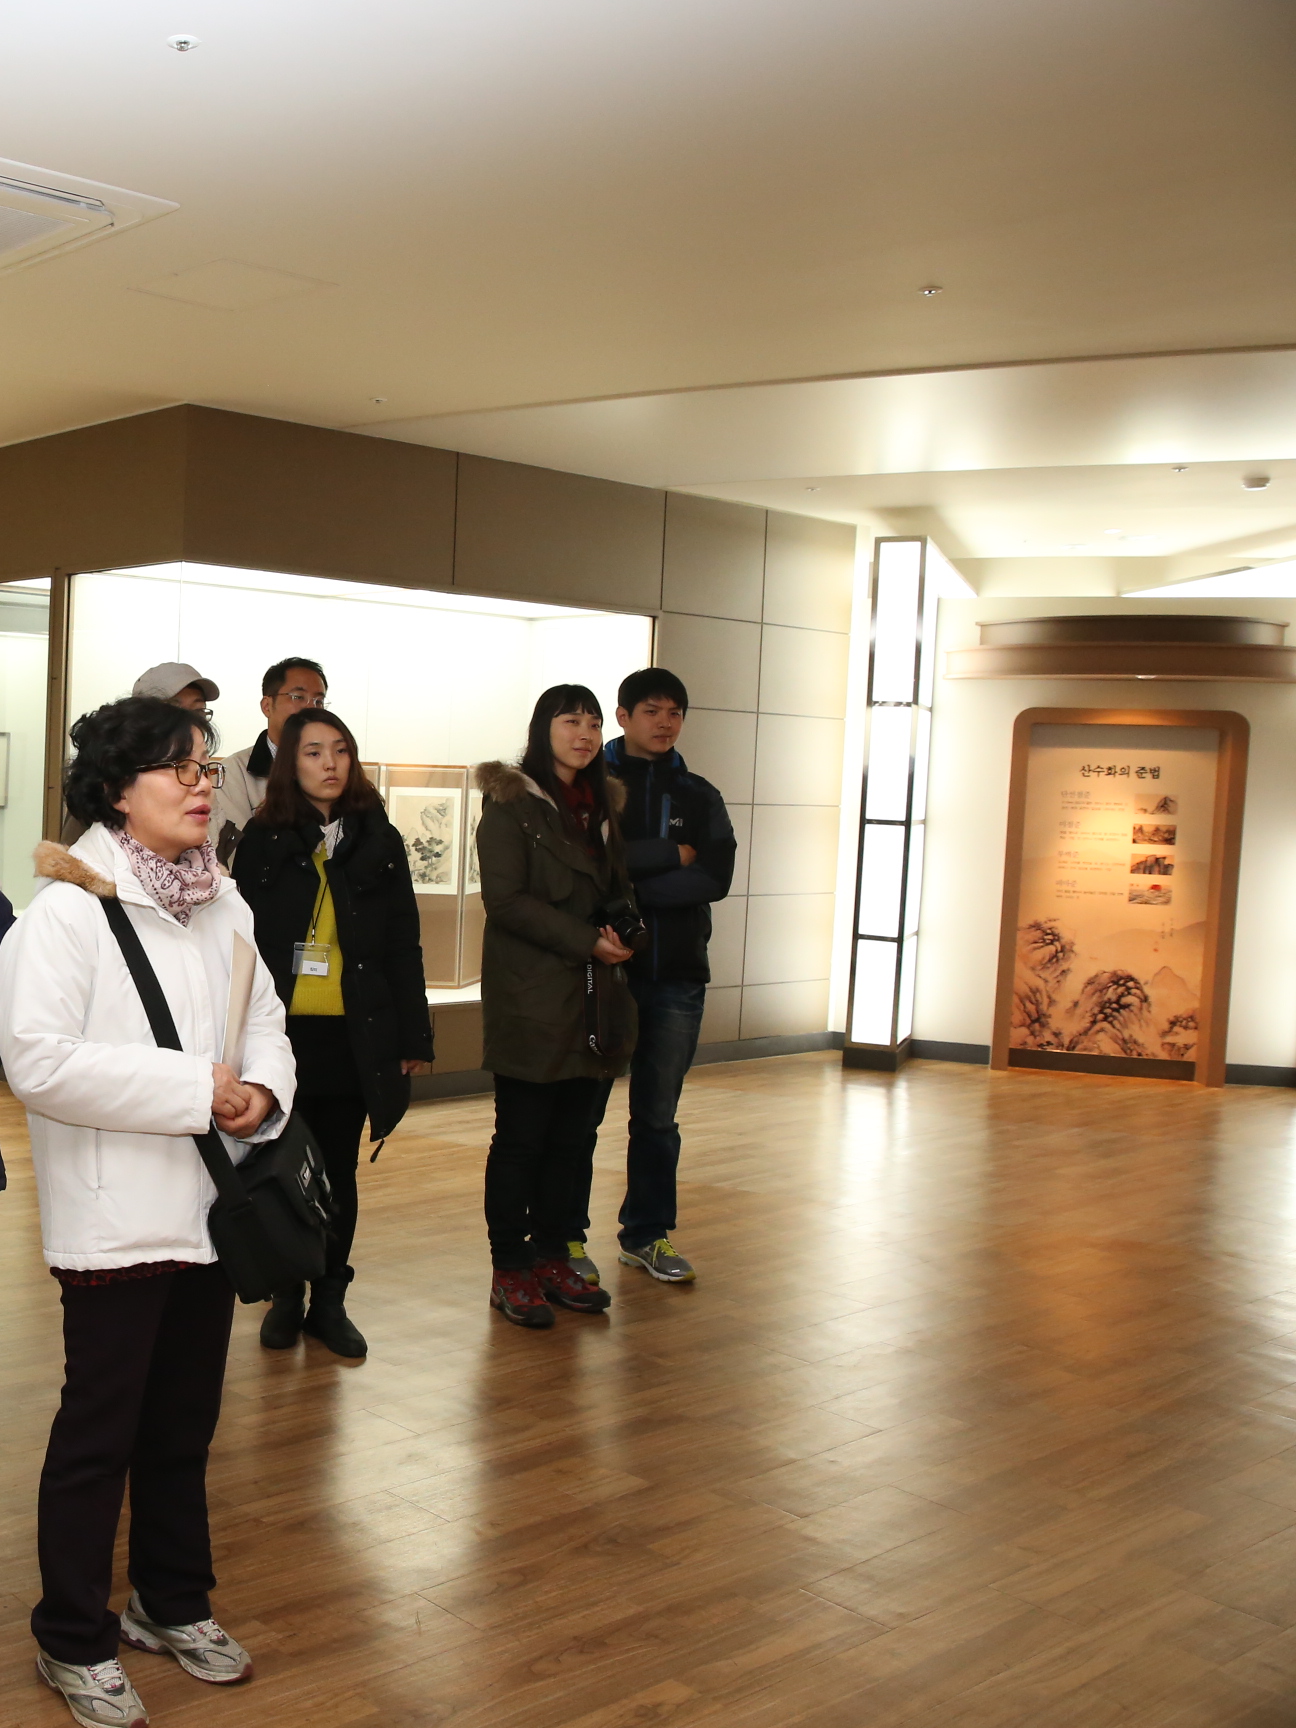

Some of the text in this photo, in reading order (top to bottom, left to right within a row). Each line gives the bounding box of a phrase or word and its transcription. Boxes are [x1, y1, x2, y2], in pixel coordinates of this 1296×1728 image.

[1079, 764, 1161, 779] 산수화의 준법
[586, 964, 594, 995] DIGITAL
